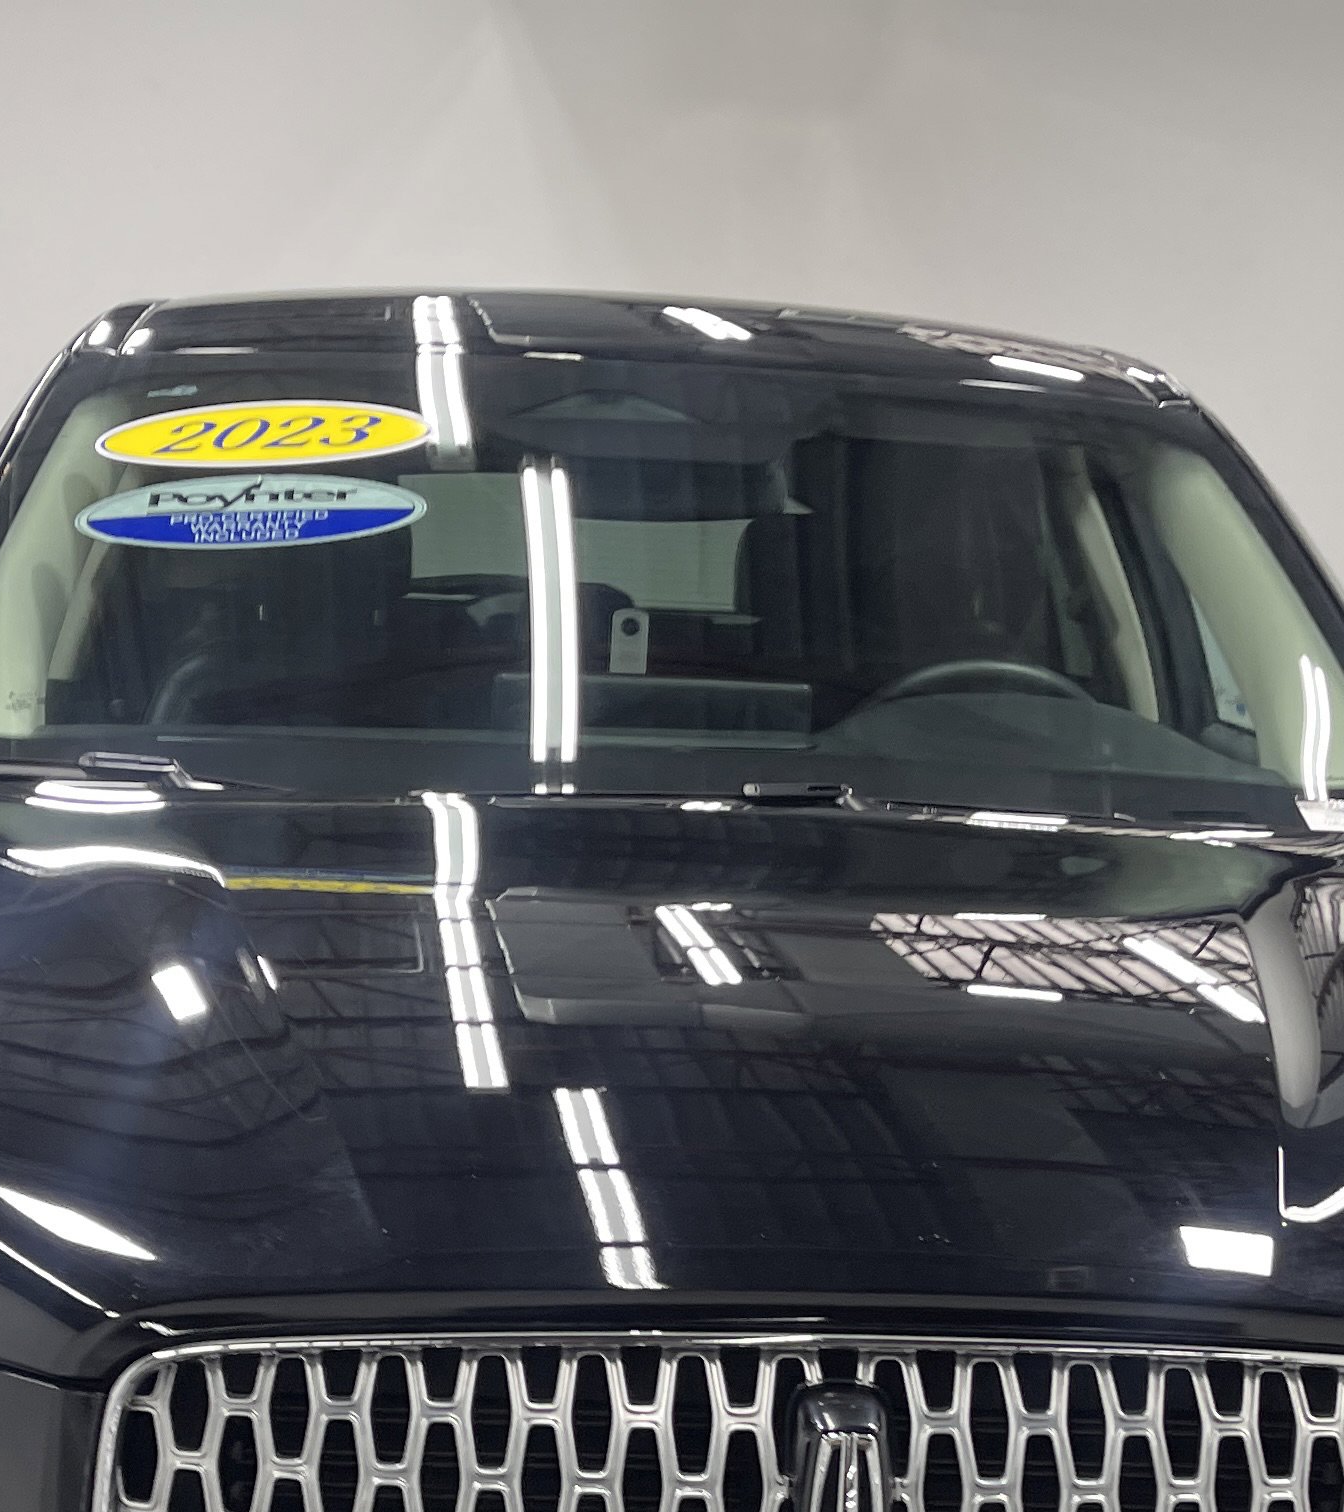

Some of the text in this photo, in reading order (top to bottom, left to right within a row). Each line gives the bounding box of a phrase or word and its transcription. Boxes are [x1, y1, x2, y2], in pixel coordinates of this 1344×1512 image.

[151, 414, 382, 456] 2023
[146, 475, 358, 514] Poynter
[194, 528, 300, 543] INCLUDED
